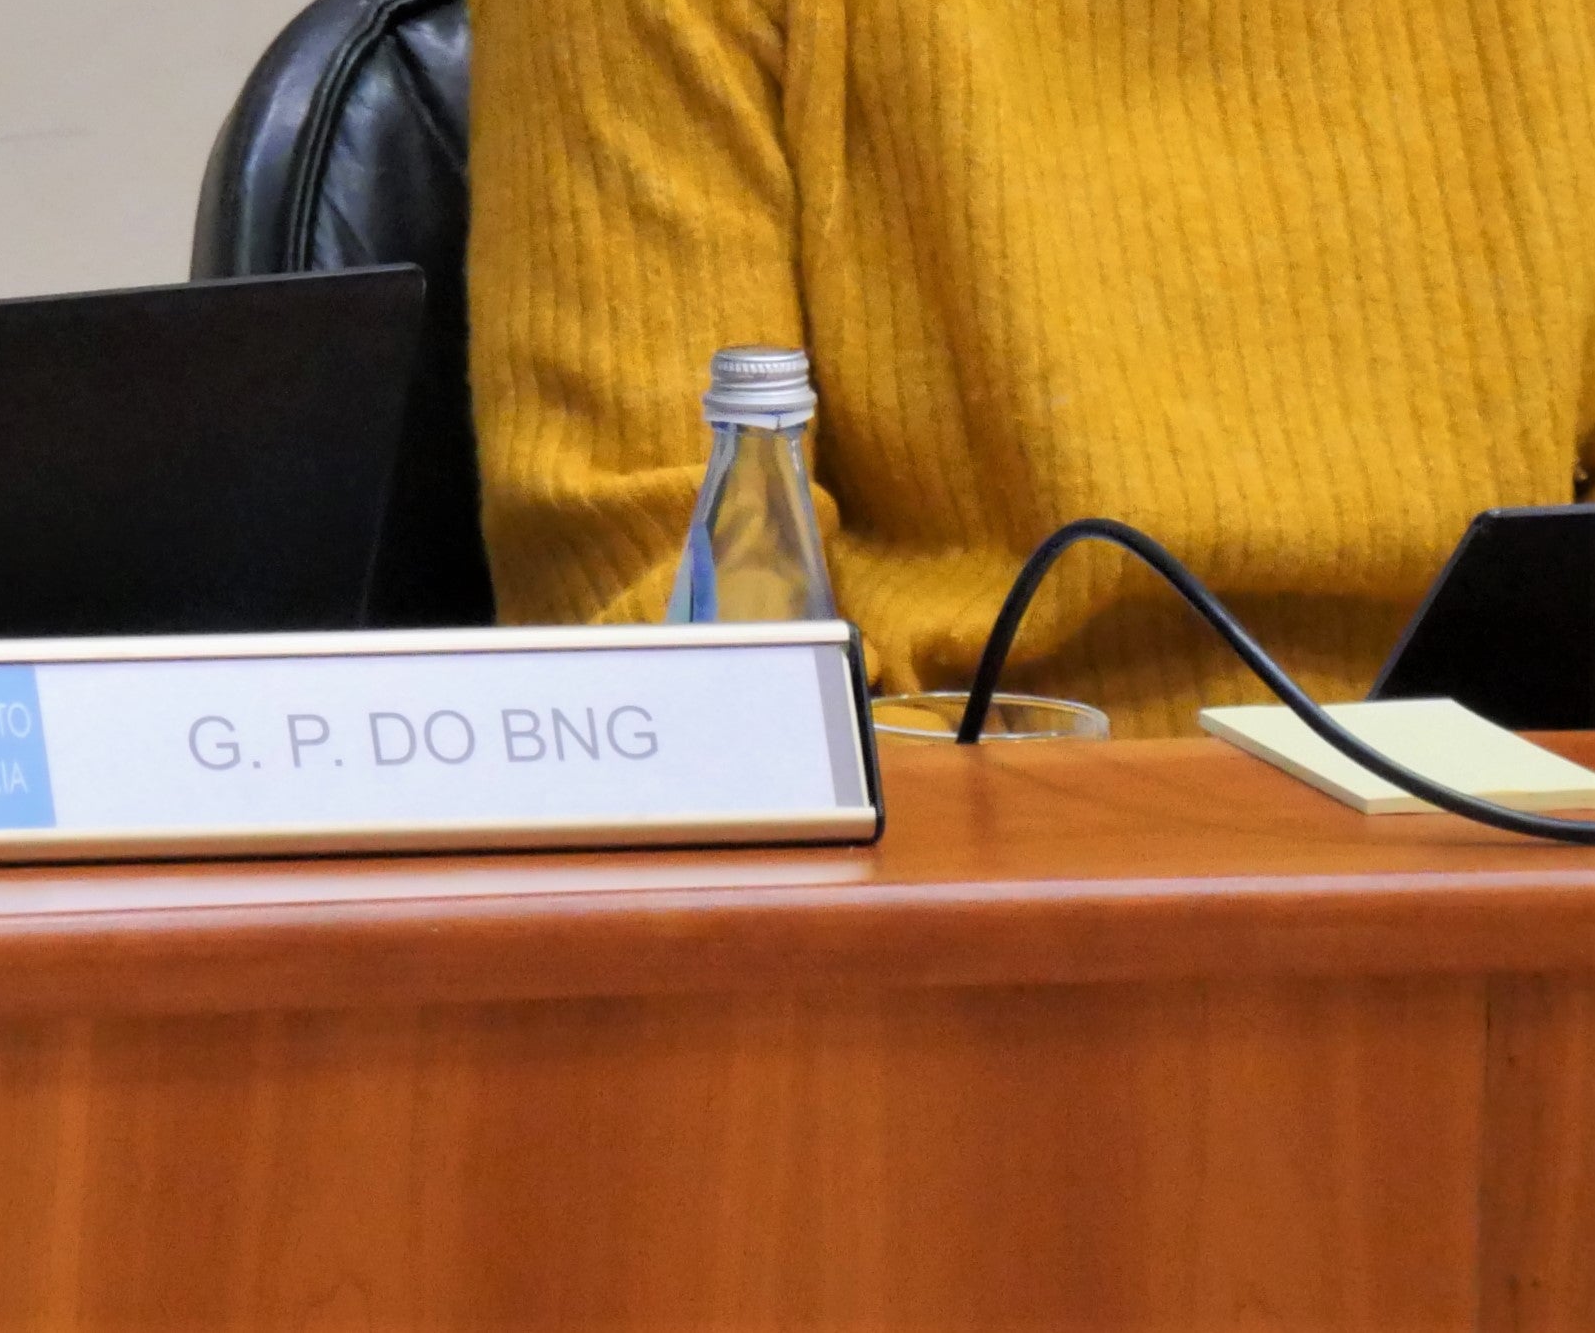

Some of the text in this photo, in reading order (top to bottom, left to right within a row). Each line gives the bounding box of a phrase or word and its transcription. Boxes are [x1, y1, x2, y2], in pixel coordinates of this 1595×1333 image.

[187, 704, 659, 771] G. P. DO BNG
